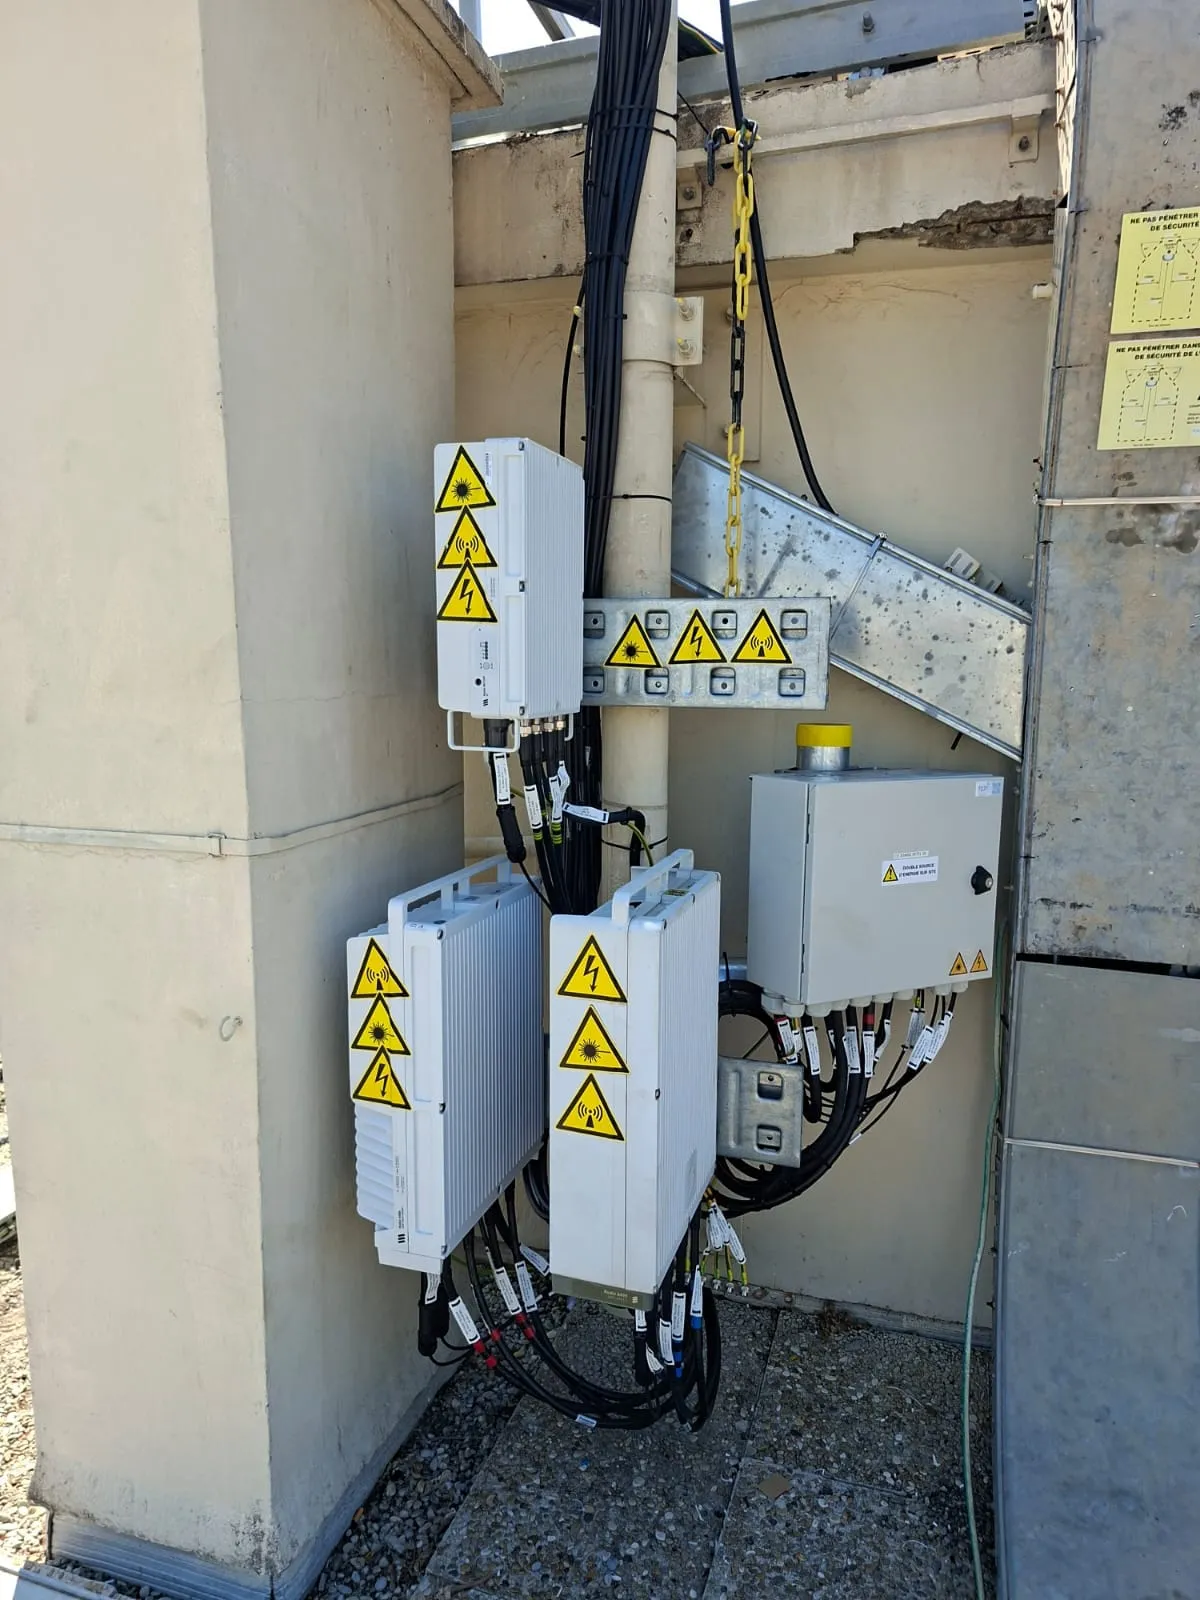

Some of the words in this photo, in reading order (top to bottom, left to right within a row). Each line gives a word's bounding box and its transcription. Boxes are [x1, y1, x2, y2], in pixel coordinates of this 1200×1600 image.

[1159, 213, 1199, 221] PÉNÉTRER
[1163, 220, 1200, 230] SÉCURITÉ
[1143, 343, 1180, 351] PÉNÉTRER
[1147, 351, 1181, 359] SÉCURITÉ
